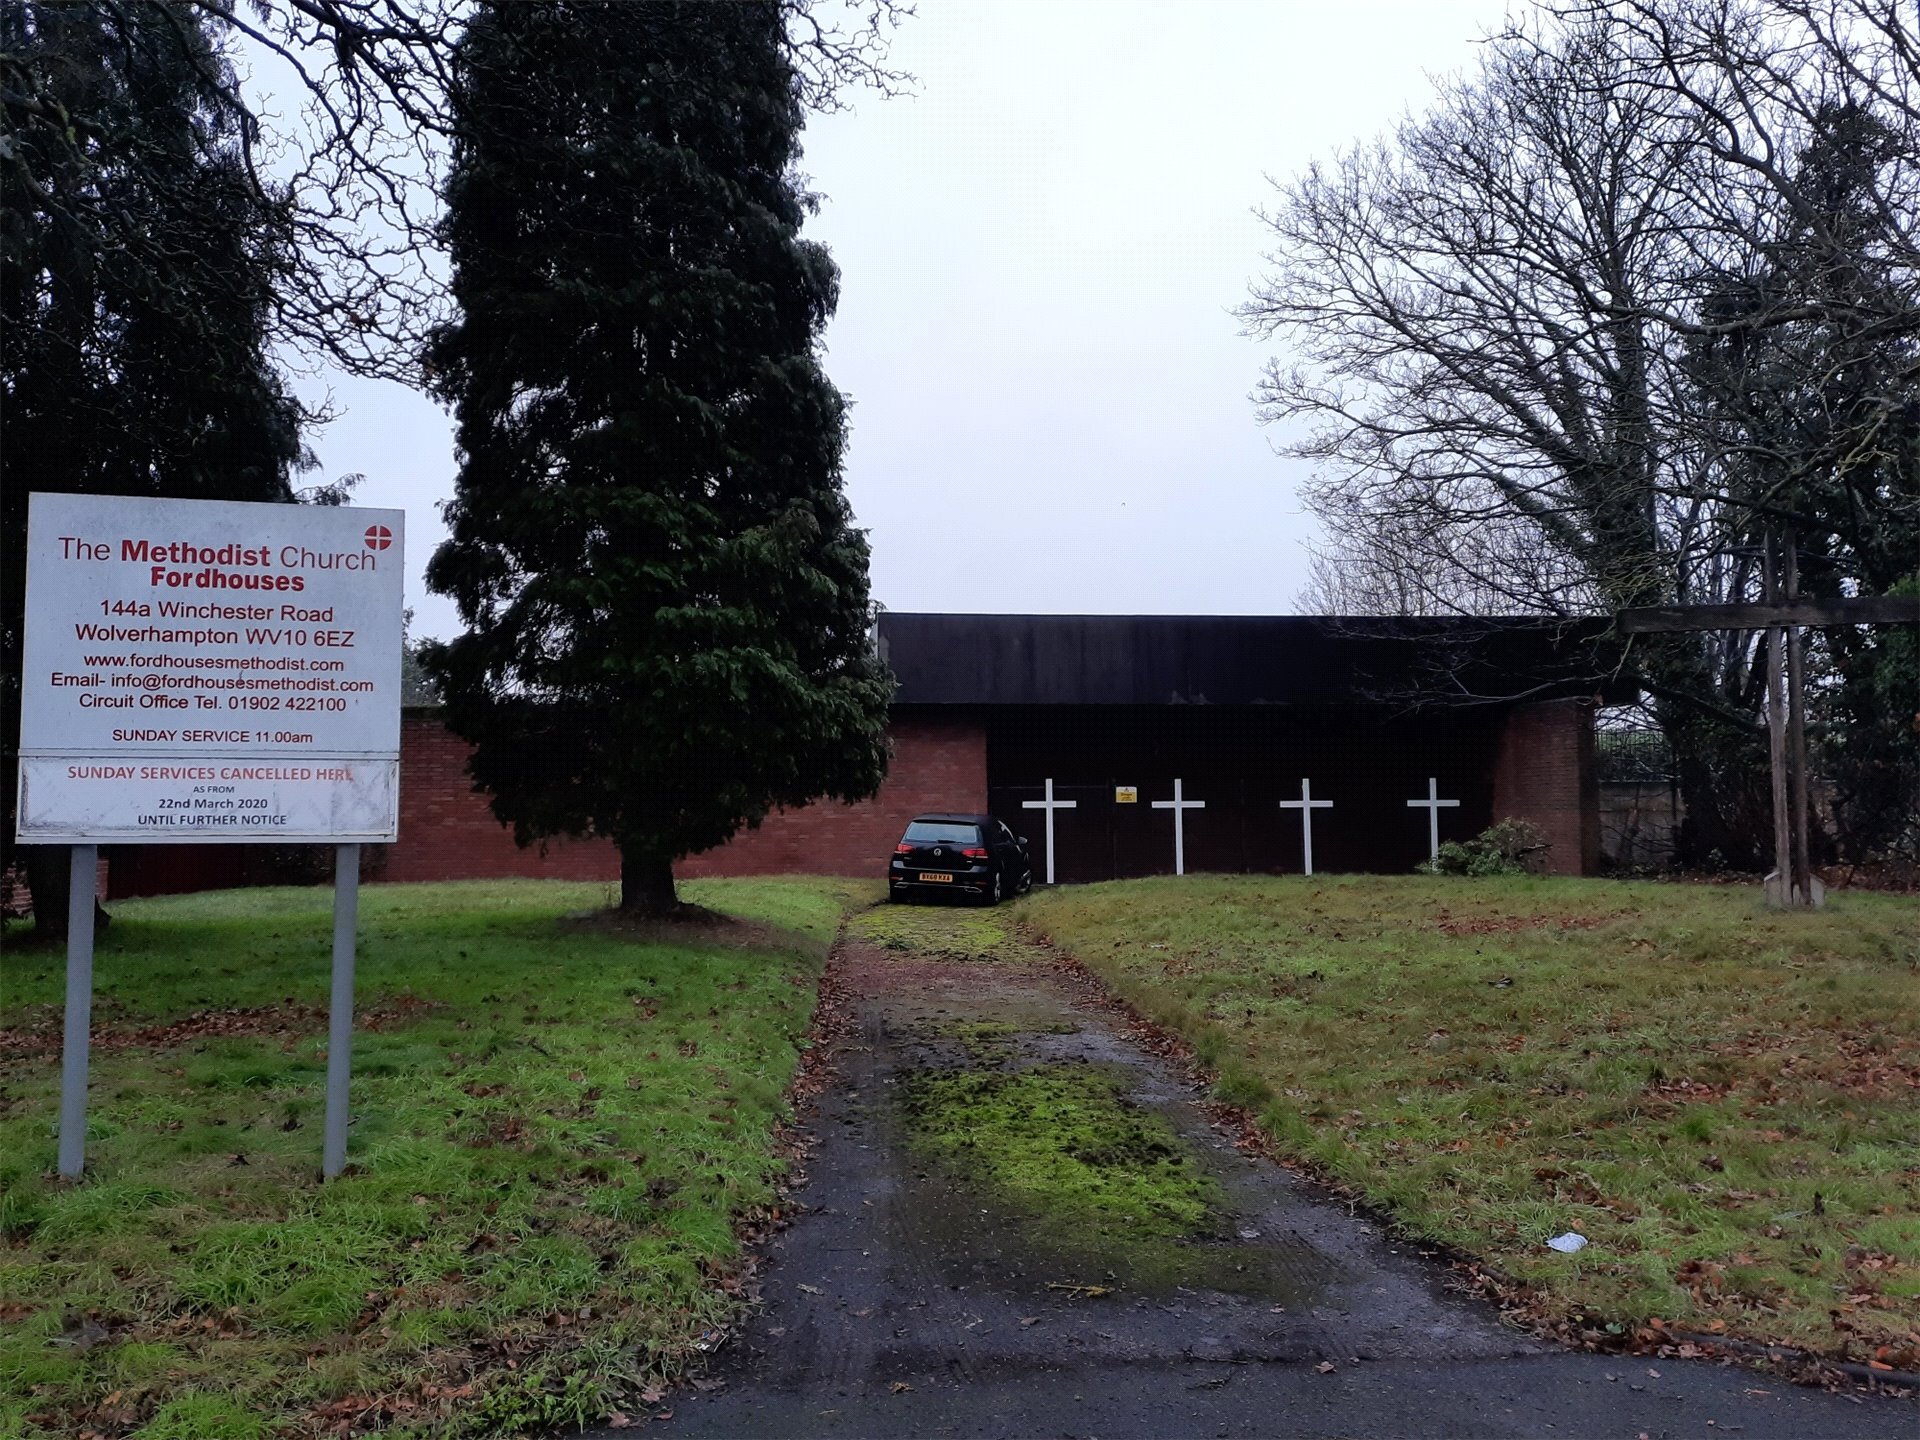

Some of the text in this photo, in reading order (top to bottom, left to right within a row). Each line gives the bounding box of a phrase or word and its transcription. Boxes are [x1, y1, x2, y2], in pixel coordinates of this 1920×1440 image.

[58, 537, 376, 570] The Methodist Church
[151, 566, 304, 591] Fordhouses
[100, 600, 333, 622] 144a Winchester Road
[75, 624, 355, 647] Wolverhampton WV10 6EZ
[84, 654, 344, 671] www.fordhousesmethodist.com
[51, 673, 374, 691] Email- info@fordhousesmethodist.com
[79, 694, 346, 711] Circuit Office Tel. 01902 422100
[112, 729, 313, 743] SUNDAY SERVICE 11.00am
[67, 766, 136, 779] SUNDAY
[140, 767, 216, 780] SERVICES
[220, 767, 311, 780] CANCELLED
[158, 799, 268, 809] 22nd March 2020
[138, 815, 287, 825] UNTIL FURTHER NOTICE
